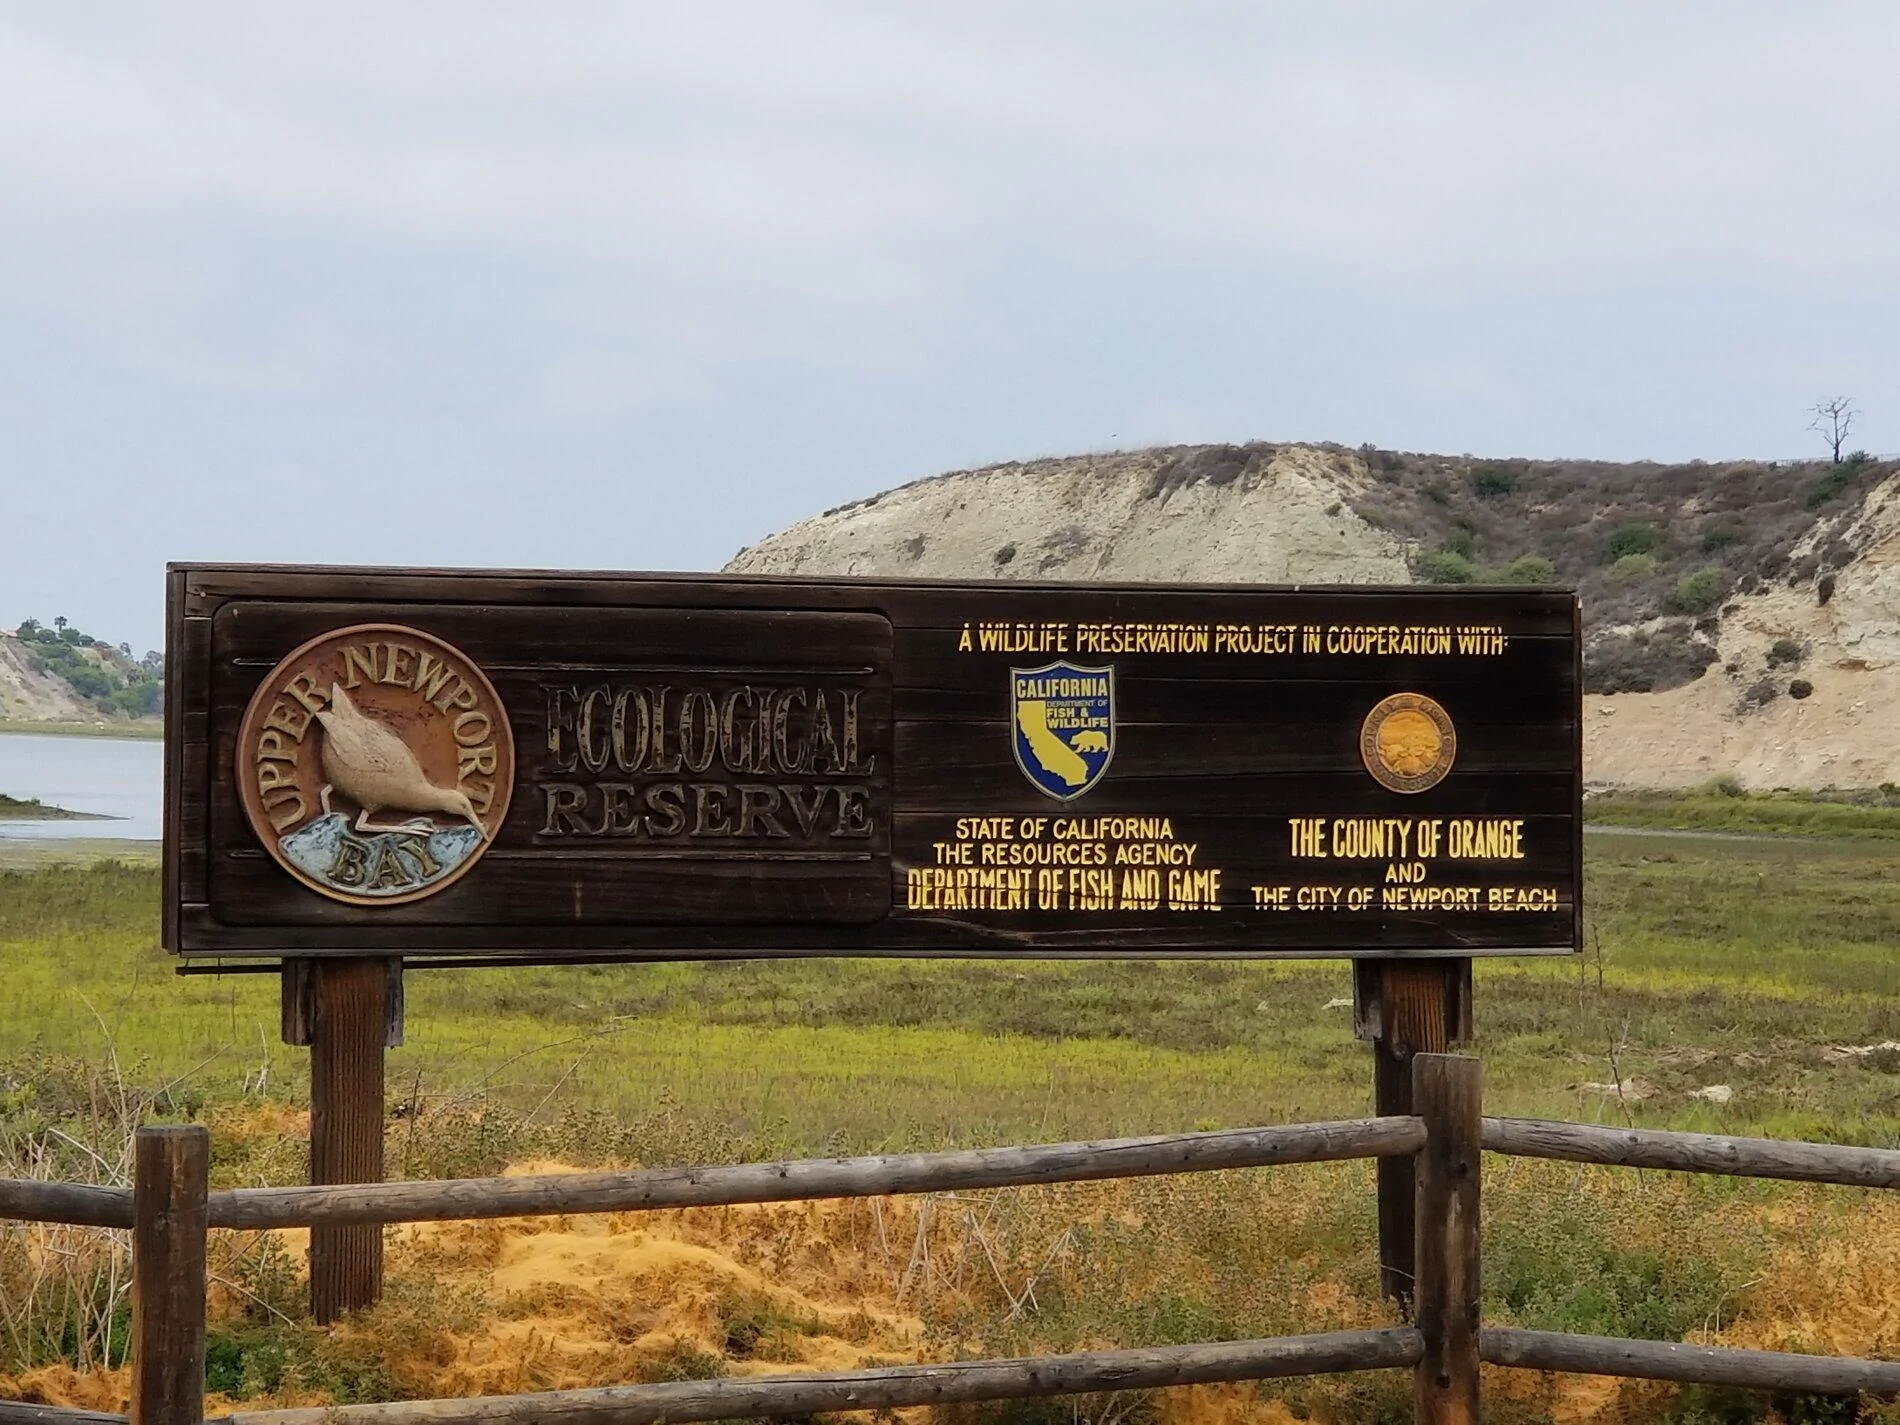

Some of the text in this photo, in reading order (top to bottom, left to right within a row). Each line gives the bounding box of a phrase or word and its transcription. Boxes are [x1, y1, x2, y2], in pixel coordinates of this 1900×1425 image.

[958, 622, 973, 652] A
[979, 622, 1069, 652] WILDLIFE
[1076, 623, 1209, 653] PRESERVATION
[1215, 624, 1298, 654] PROJECT
[1303, 625, 1321, 654] IN
[1327, 625, 1451, 655] COOPERATION
[1016, 678, 1108, 699] CALIFORNIA
[1046, 699, 1108, 708] DEPARTMENT OF
[1046, 707, 1089, 718] FISH &
[538, 684, 876, 777] ECOLOGICAL
[1047, 717, 1108, 729] WILDLIFE
[257, 641, 498, 835] UPPER NEWPORT
[536, 783, 874, 838] RESERVE
[956, 817, 1173, 840] STATE OF CALIFORNIA
[1288, 818, 1526, 859] THE COUNTY OF ORANGE
[326, 836, 442, 889] BAY
[933, 842, 1198, 866] THE RESOURCES AGENCY
[1384, 862, 1427, 884] AND
[908, 868, 1223, 911] DEPARTMENT OF FISH AND GAME
[1251, 886, 1559, 912] THE CITY OF NEWPORT BEACH
